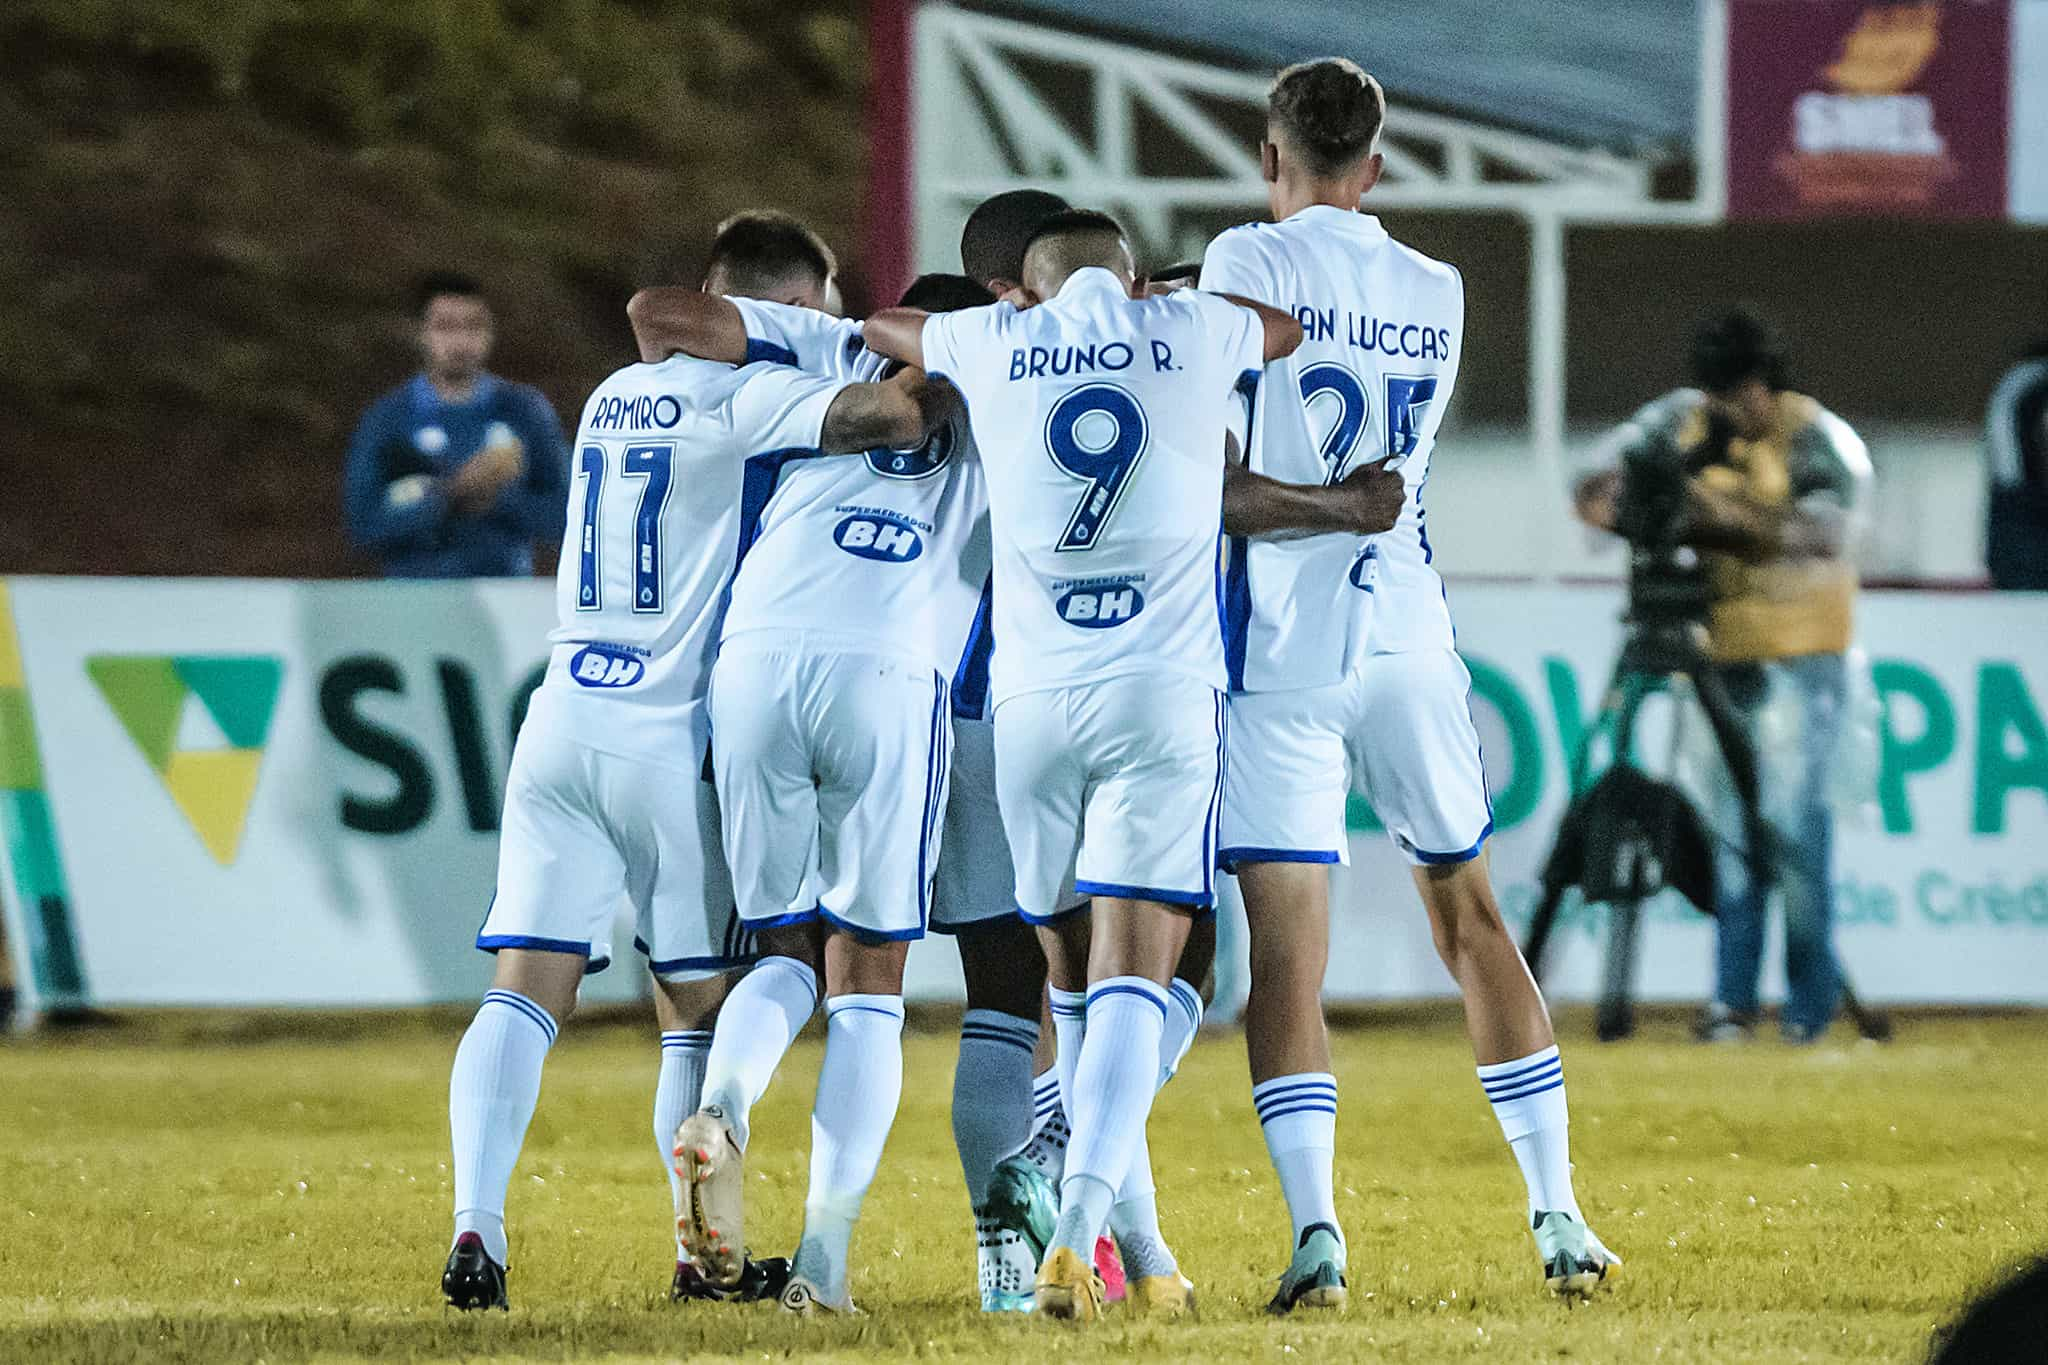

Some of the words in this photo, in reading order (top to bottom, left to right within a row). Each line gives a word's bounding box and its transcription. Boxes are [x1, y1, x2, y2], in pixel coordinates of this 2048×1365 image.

[1349, 312, 1450, 362] LUCCAS
[1009, 342, 1134, 381] BRUNO
[1151, 340, 1183, 372] R.
[590, 394, 681, 431] RAMIRO
[1043, 382, 1149, 552] 9
[576, 441, 678, 614] 17
[834, 505, 933, 533] SUPERMERCADOS
[841, 520, 916, 557] BH
[1064, 588, 1135, 620] BH
[576, 652, 641, 686] BH
[318, 653, 550, 836] SI
